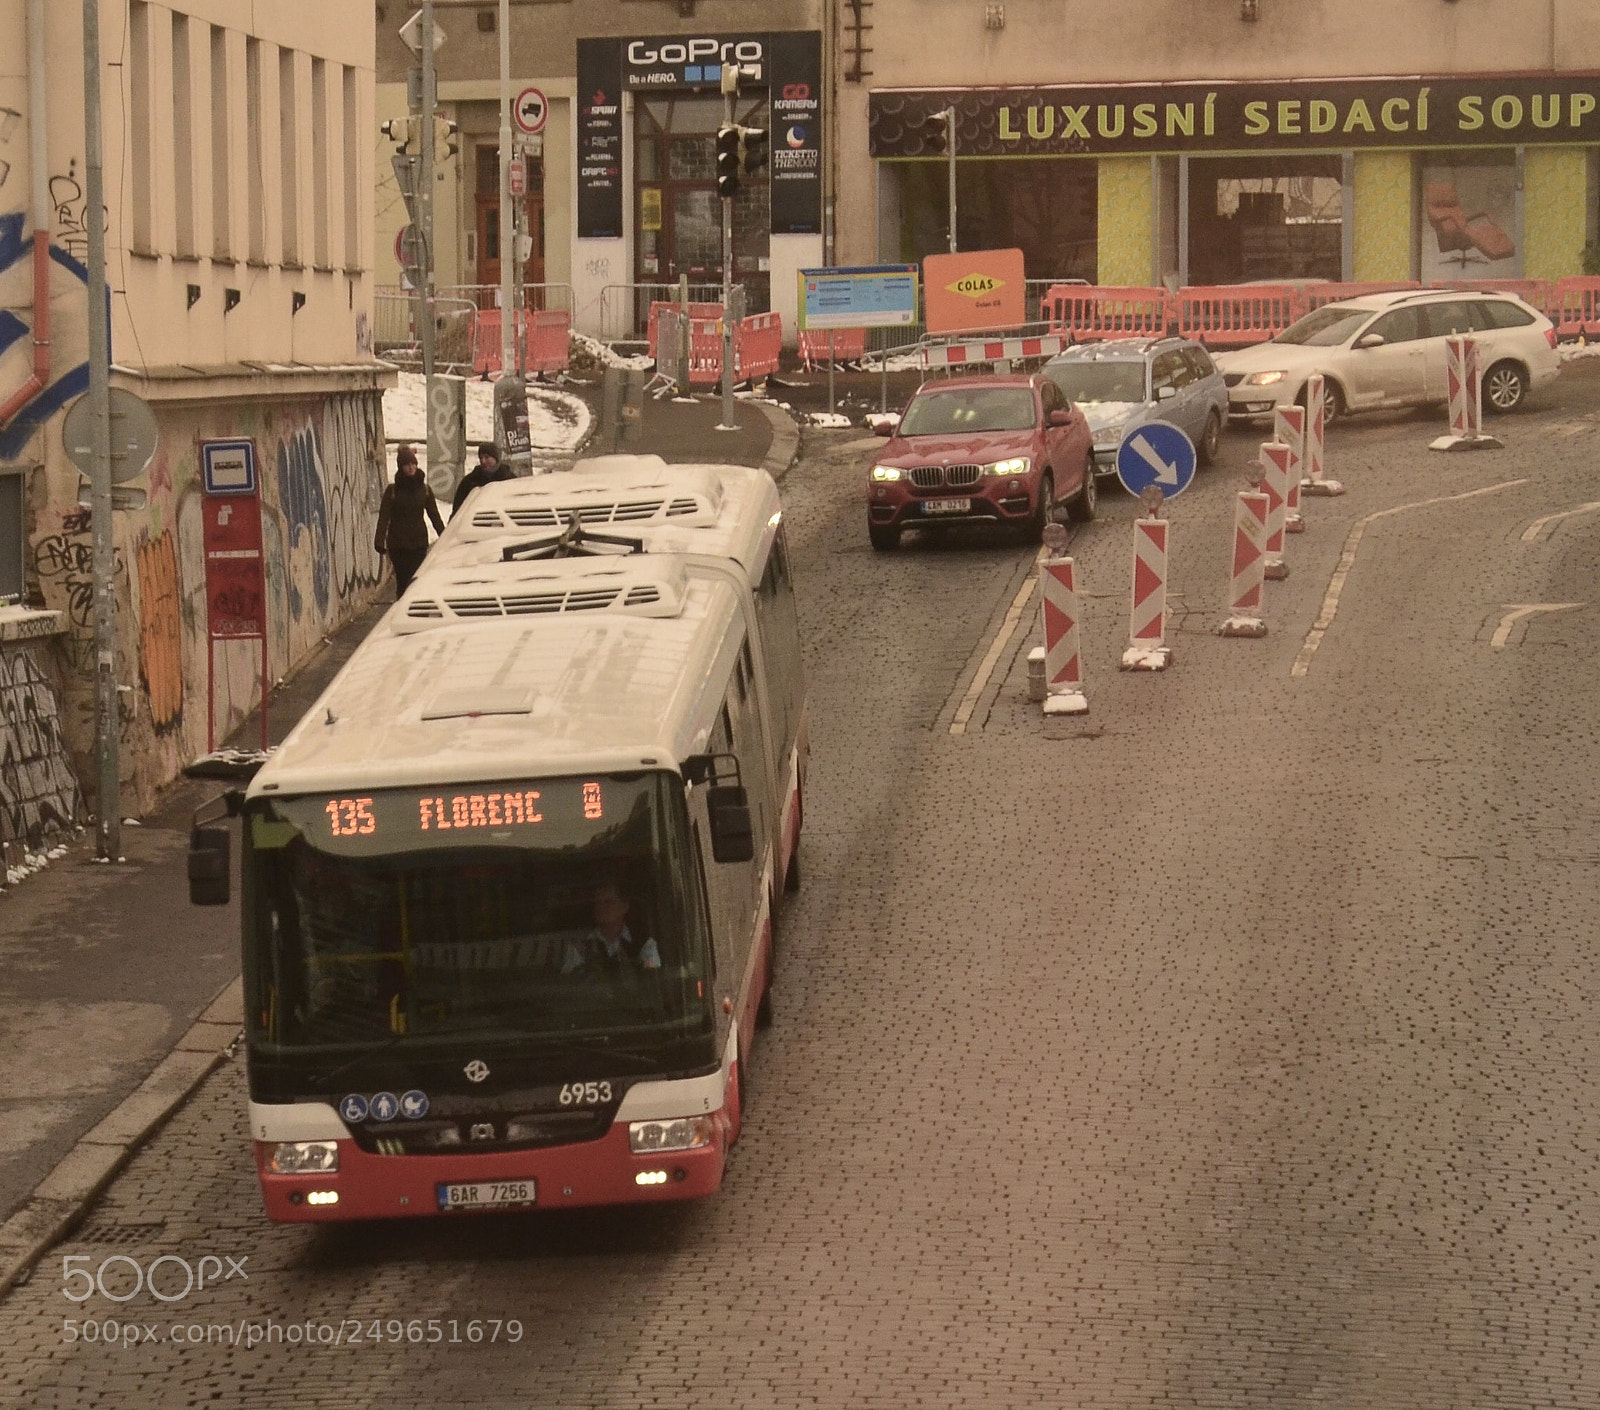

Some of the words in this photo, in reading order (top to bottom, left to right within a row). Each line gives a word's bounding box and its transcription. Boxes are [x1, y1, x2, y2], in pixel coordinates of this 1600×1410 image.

[628, 39, 762, 65] GoPro
[999, 92, 1217, 140] LUXUSNÍ
[1244, 87, 1431, 135] SEDACÍ
[1458, 94, 1597, 131] SOUP
[957, 278, 993, 292] COLAS
[325, 797, 377, 836] 135
[559, 1081, 613, 1105] 6953
[451, 1186, 478, 1203] 6AR
[490, 1183, 528, 1201] 7256
